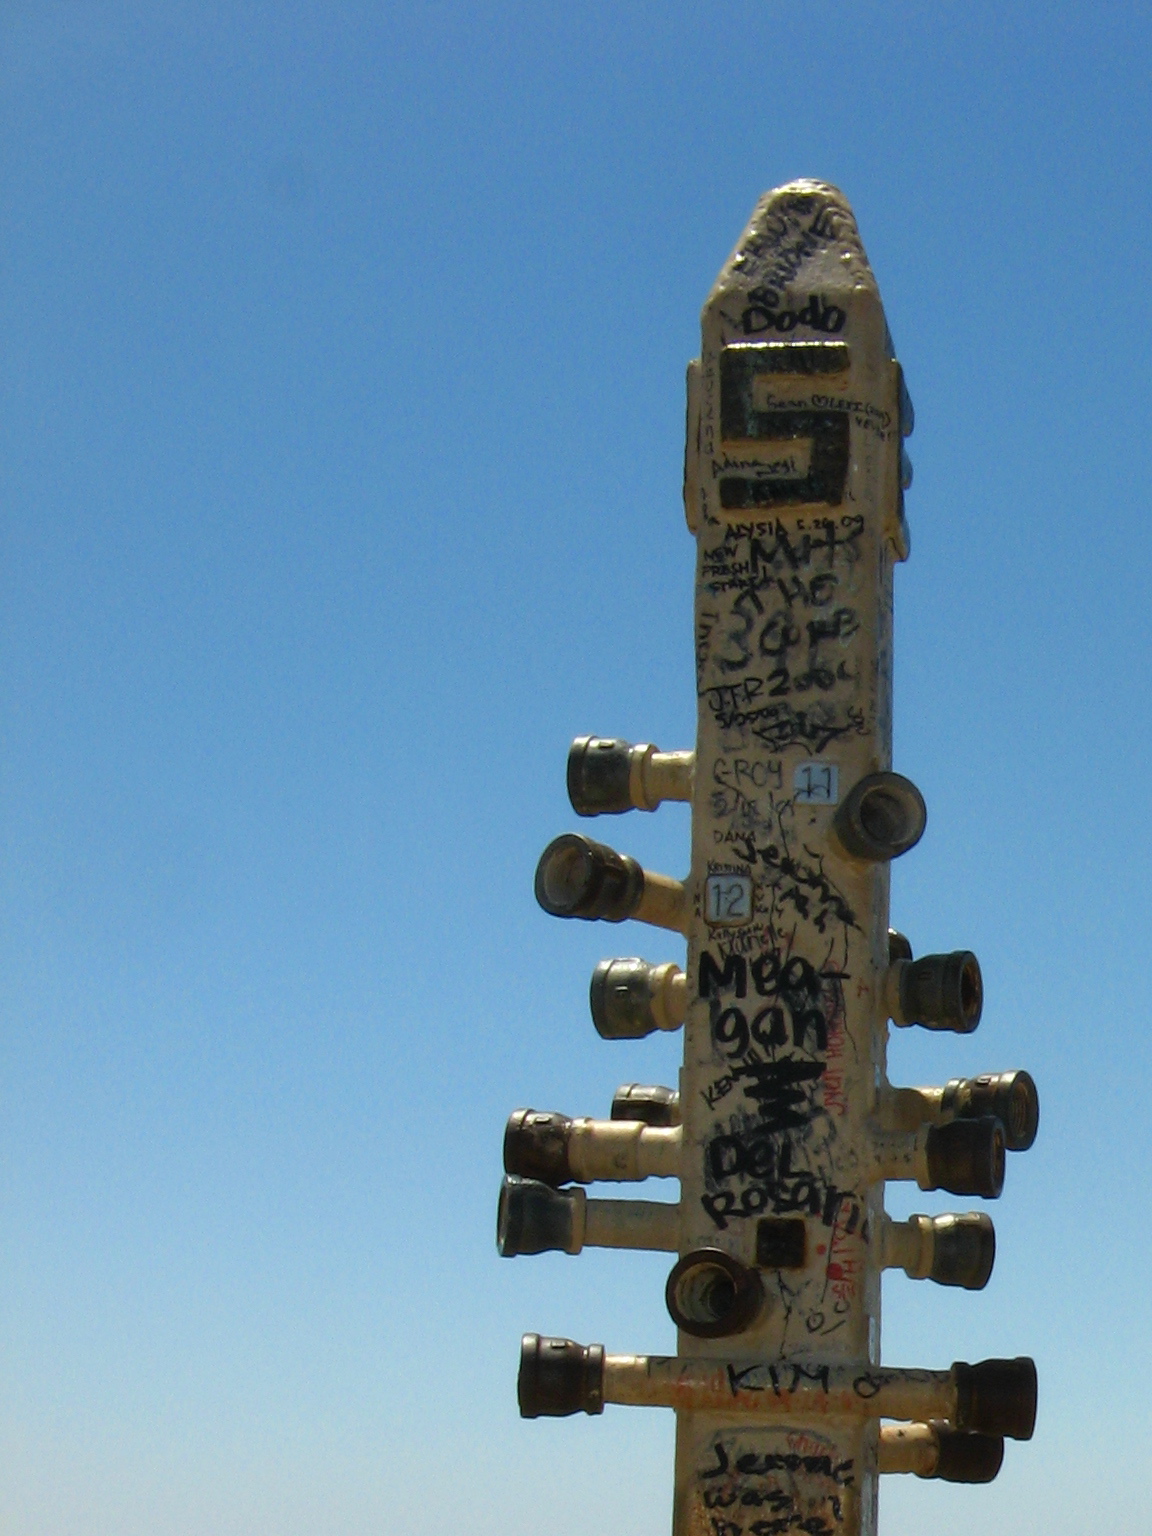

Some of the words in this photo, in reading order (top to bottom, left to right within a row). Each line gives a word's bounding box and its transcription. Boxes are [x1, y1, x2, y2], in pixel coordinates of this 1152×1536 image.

[801, 766, 832, 799] 11
[712, 882, 745, 917] 12
[726, 1362, 831, 1398] KIM
